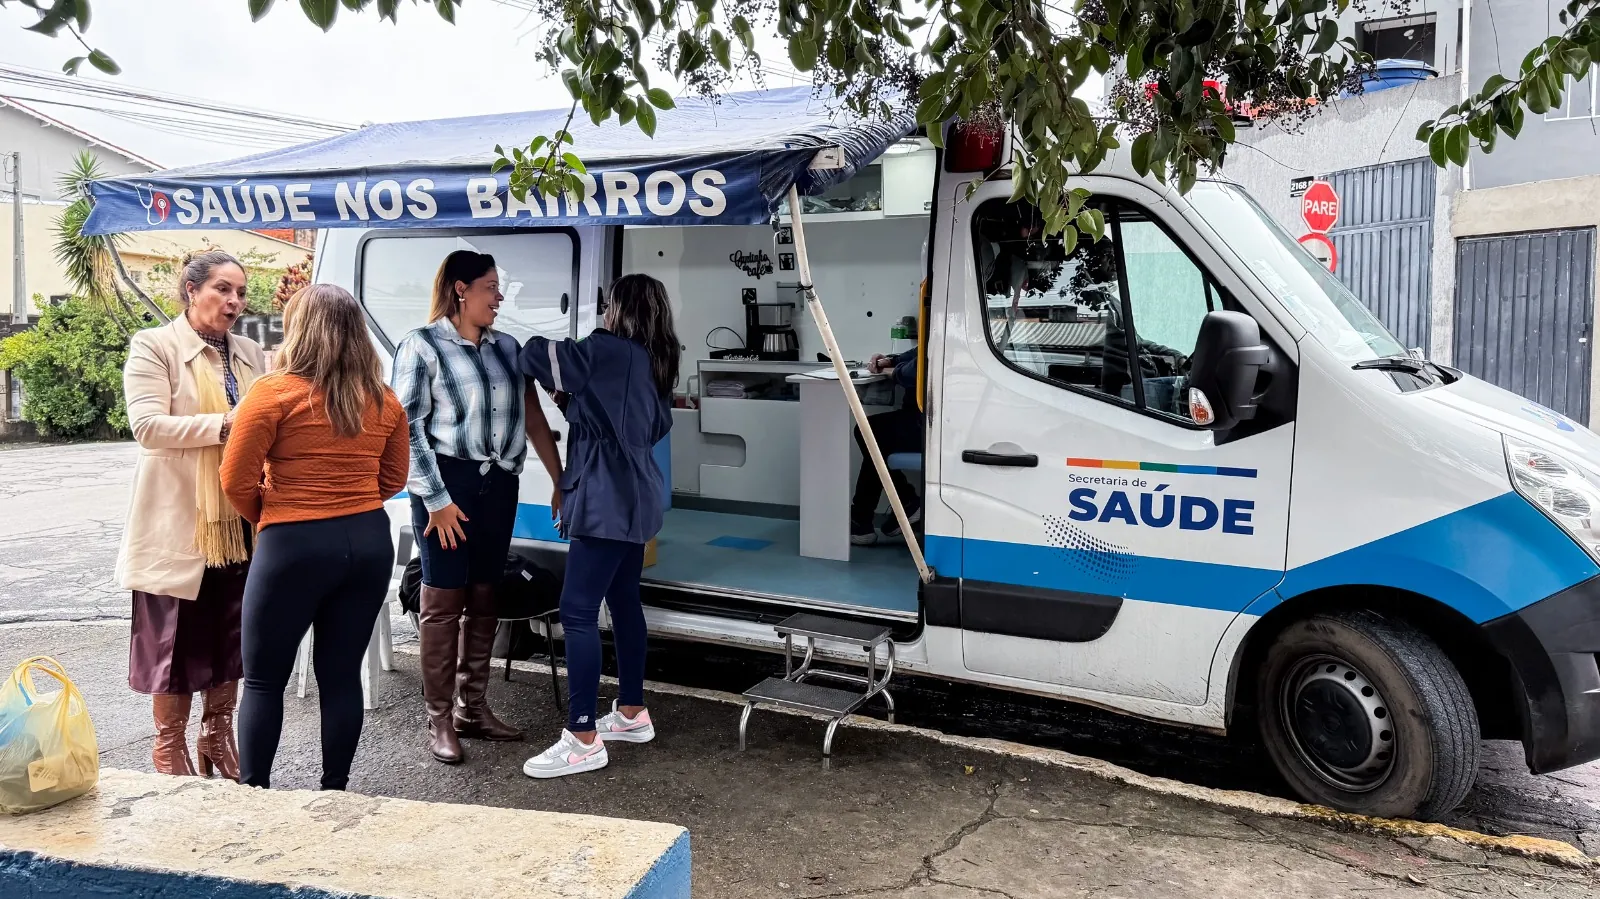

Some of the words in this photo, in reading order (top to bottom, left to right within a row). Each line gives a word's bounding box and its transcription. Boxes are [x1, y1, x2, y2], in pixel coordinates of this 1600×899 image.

[1291, 181, 1307, 190] 2168
[173, 179, 316, 224] SAÚDE
[336, 180, 437, 221] NOS
[467, 170, 727, 218] BAIRROS
[1305, 200, 1337, 216] PARE
[1068, 473, 1128, 487] Secretaria
[1132, 478, 1147, 488] de
[1068, 484, 1255, 535] SAÚDE
